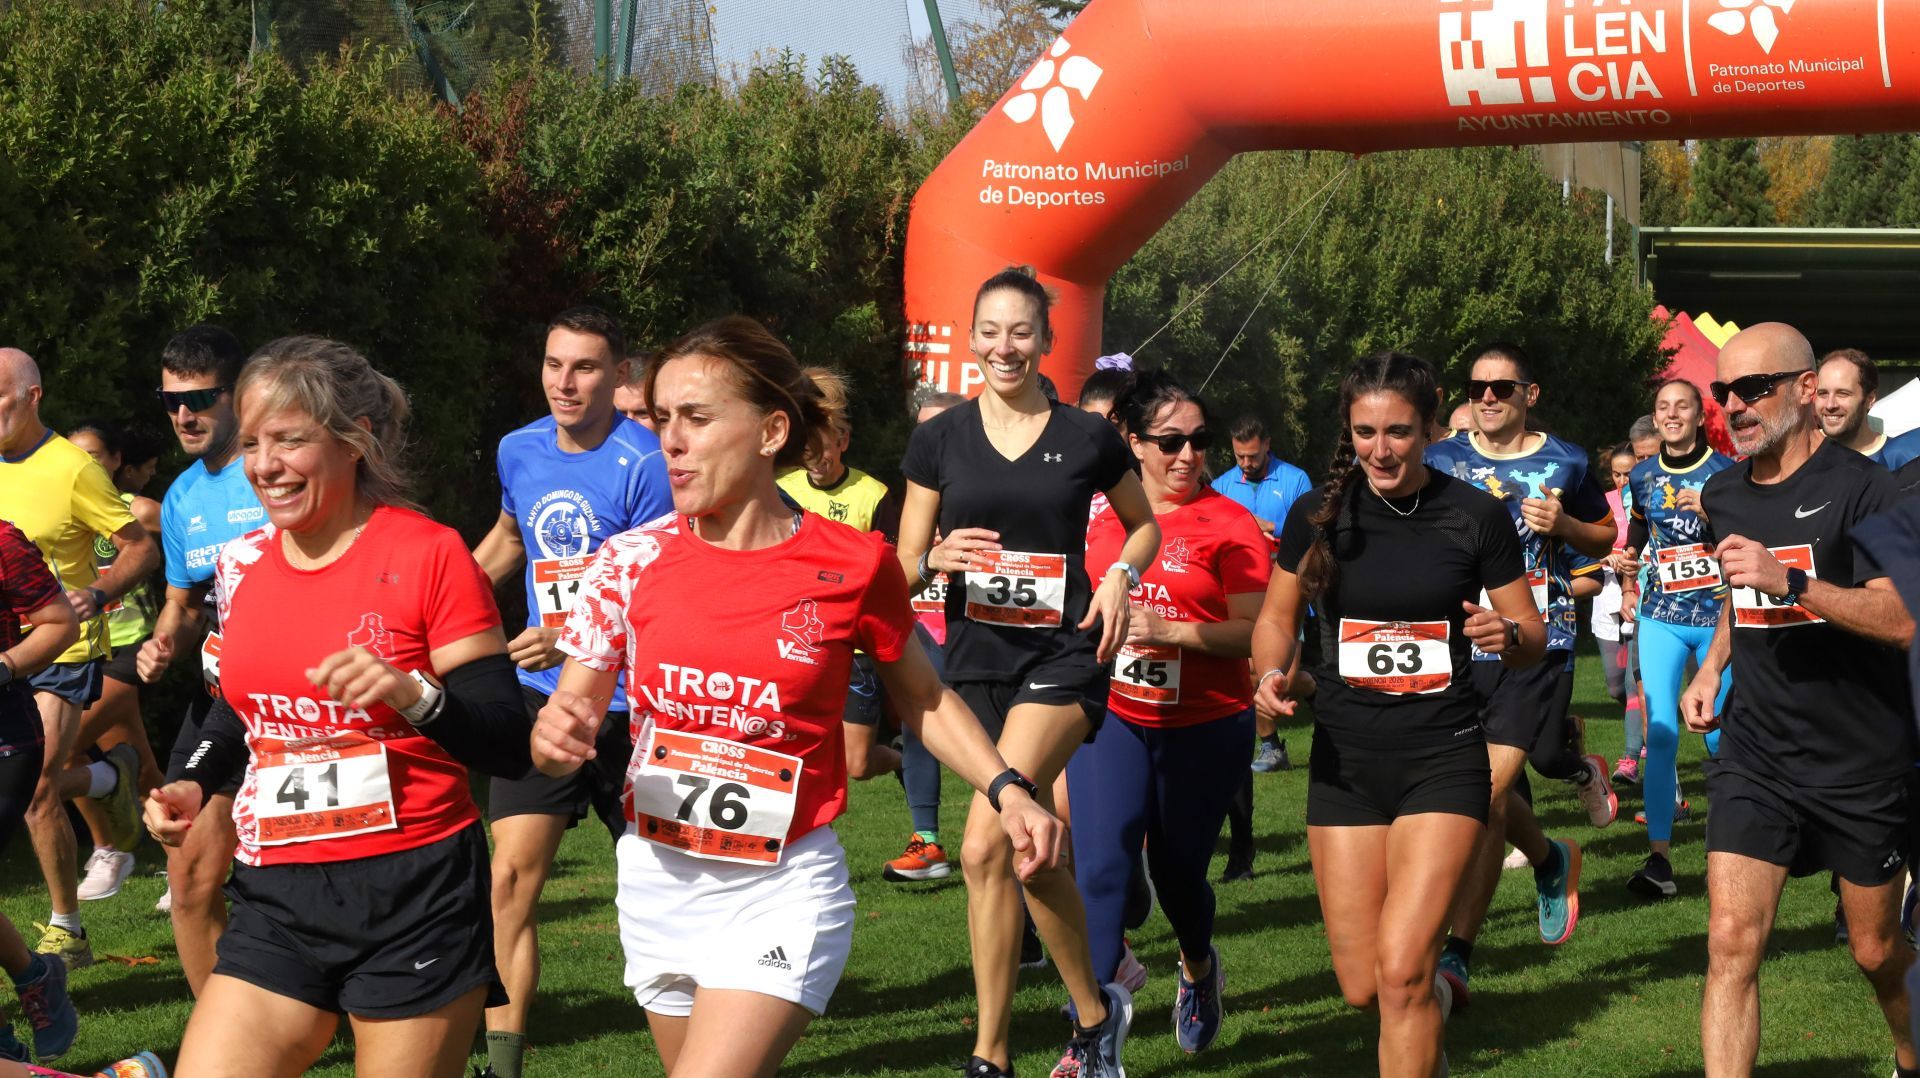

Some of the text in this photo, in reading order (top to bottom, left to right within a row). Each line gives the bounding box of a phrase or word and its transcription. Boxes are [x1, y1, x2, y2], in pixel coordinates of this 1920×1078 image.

[1563, 9, 1666, 57] LEN
[1709, 56, 1864, 77] Patronato Municipal
[1567, 60, 1664, 102] CIA
[1712, 79, 1806, 94] de Deportes
[1457, 108, 1671, 131] AYUNTAMIENTO
[981, 154, 1190, 181] Patronato Municipal
[979, 185, 1106, 209] de Deportes
[960, 362, 986, 395] P
[526, 500, 542, 528] SANTO
[541, 489, 575, 505] DOMINGO
[572, 492, 584, 504] DE
[1000, 553, 1031, 563] CROSS
[1667, 557, 1711, 580] 153
[995, 566, 1035, 577] Palencia
[987, 575, 1037, 608] 35
[1374, 633, 1416, 642] Palencia
[1367, 642, 1423, 676] 63
[658, 662, 781, 713] TROTA
[247, 693, 374, 725] TROTA
[640, 684, 786, 739] VENTEÑ@S
[283, 749, 342, 764] Palencia
[700, 740, 746, 760] CROSS
[690, 759, 748, 782] Palencia
[276, 762, 339, 811] 41
[676, 773, 751, 830] 76
[757, 958, 792, 971] adidas
